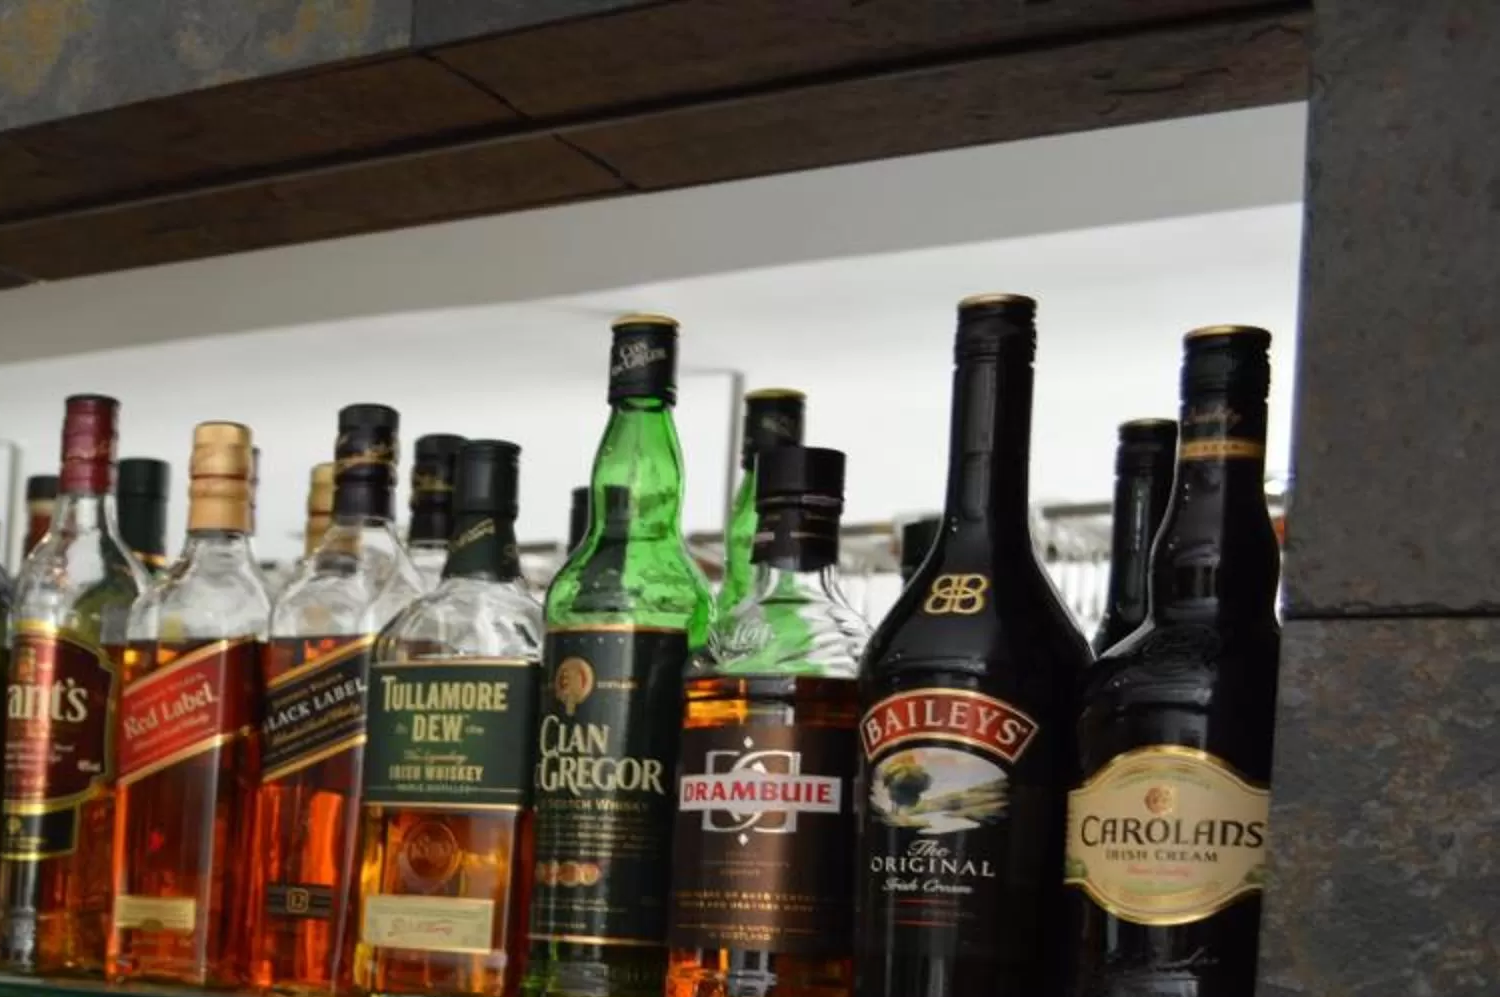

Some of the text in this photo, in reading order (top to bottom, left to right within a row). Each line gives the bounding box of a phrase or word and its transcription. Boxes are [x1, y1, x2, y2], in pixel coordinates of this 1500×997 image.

[7, 678, 89, 723] ant's
[312, 677, 368, 711] LABEL
[380, 675, 509, 712] TULLAMORE
[411, 713, 464, 743] DEW
[867, 699, 1024, 746] BAILEYS
[540, 756, 667, 796] GREGOR
[683, 779, 834, 804] DRAMBUIE
[1081, 815, 1266, 848] CAROLANS
[871, 855, 997, 877] ORIGINAL
